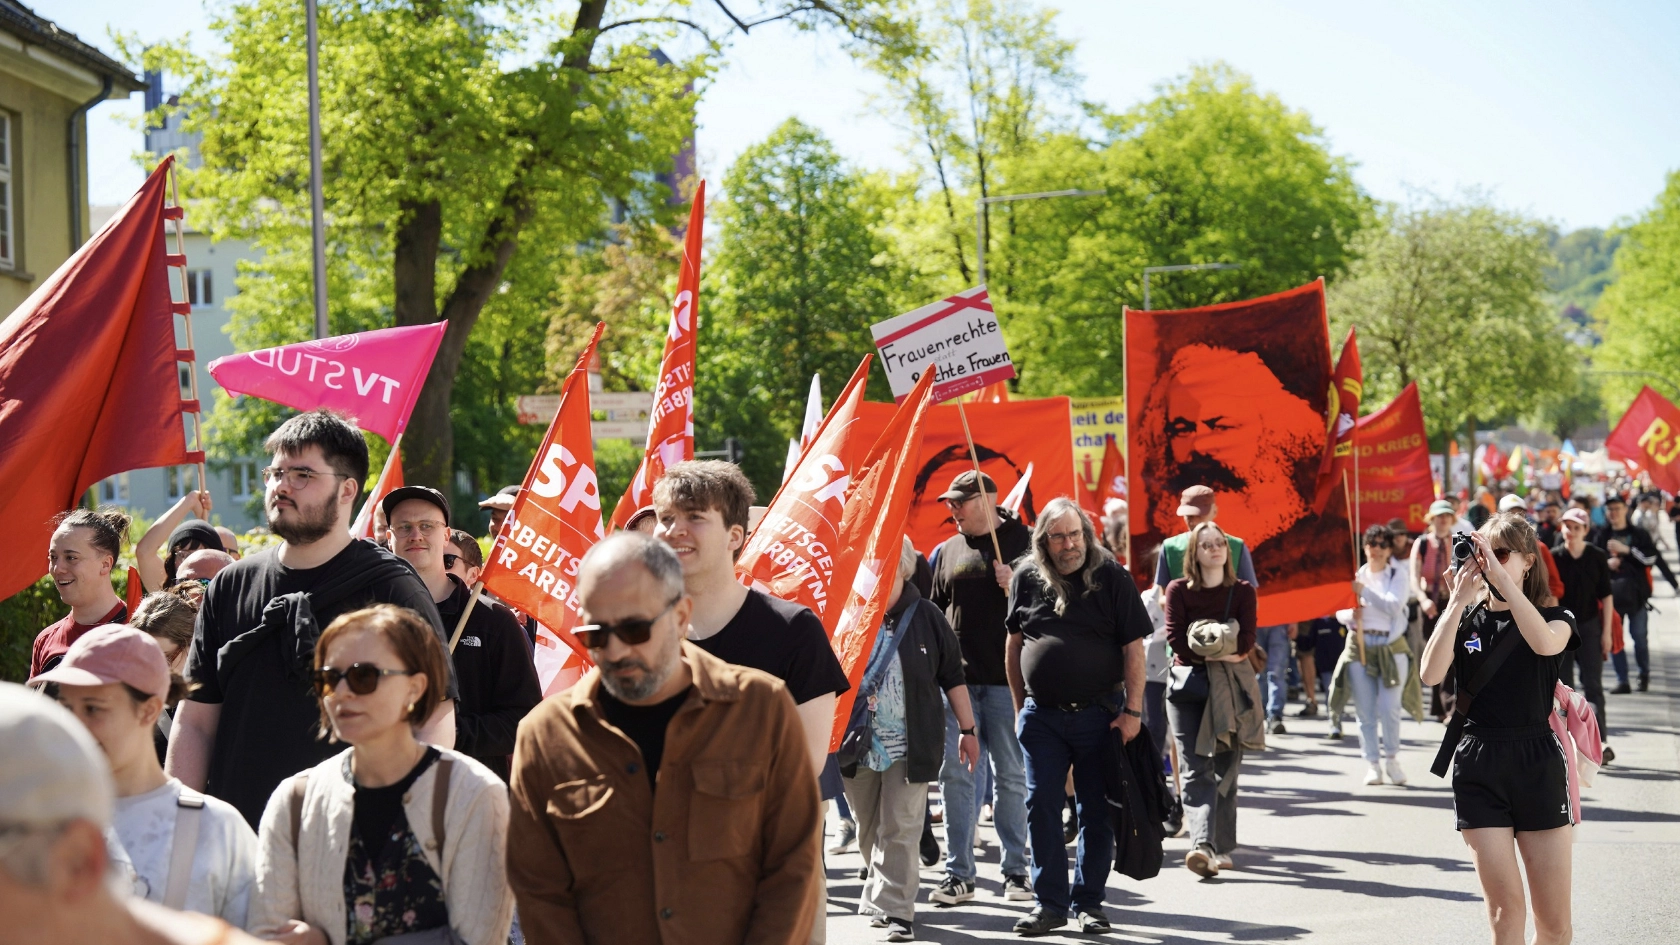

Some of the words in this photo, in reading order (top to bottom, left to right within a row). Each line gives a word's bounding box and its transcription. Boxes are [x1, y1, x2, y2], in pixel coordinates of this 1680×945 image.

[881, 318, 998, 373] Frauenrechte
[911, 362, 967, 383] Rchte
[967, 351, 1010, 372] Frauen
[1072, 411, 1097, 426] eit
[1377, 434, 1422, 454] KRIEG
